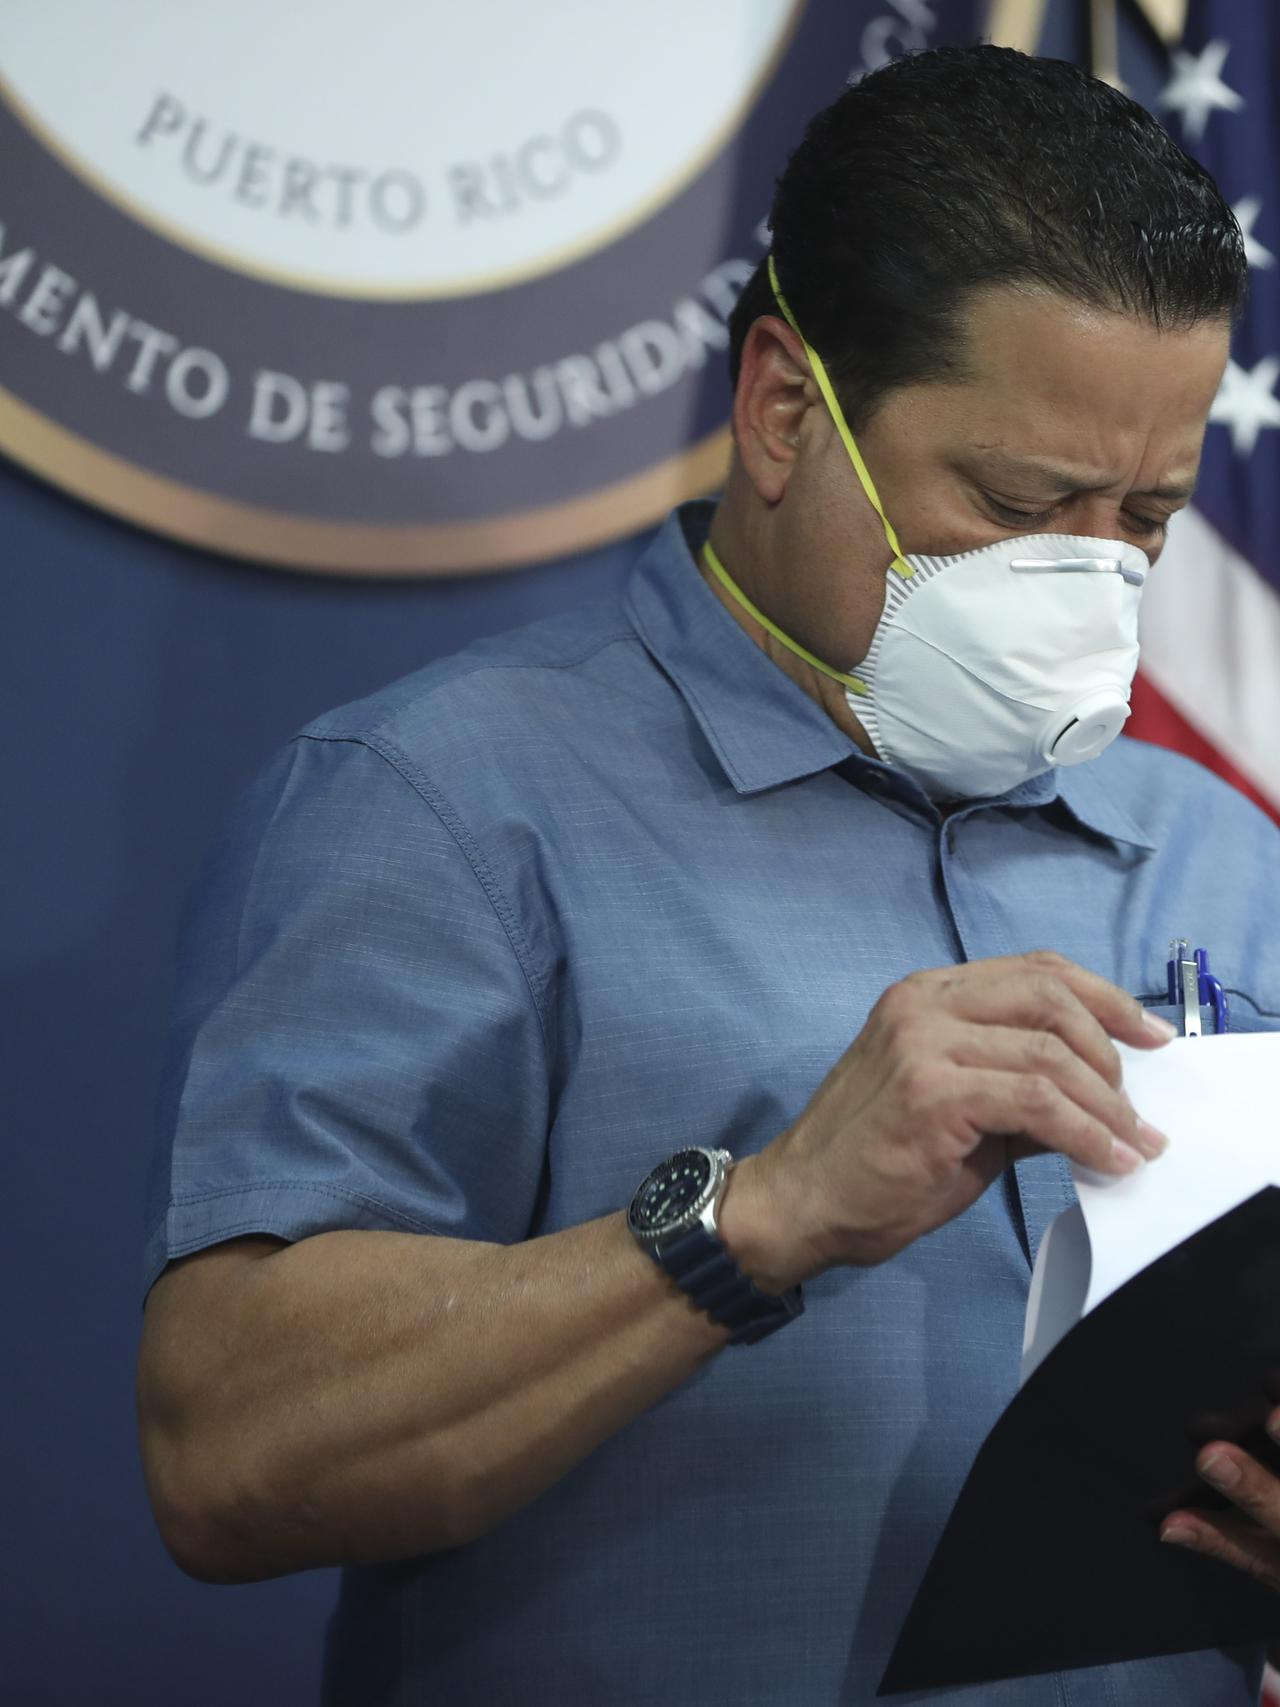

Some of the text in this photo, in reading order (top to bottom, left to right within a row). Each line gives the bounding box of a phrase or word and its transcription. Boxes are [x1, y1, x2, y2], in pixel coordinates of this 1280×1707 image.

[135, 91, 622, 236] PUERTO RICO
[249, 368, 350, 452] DE
